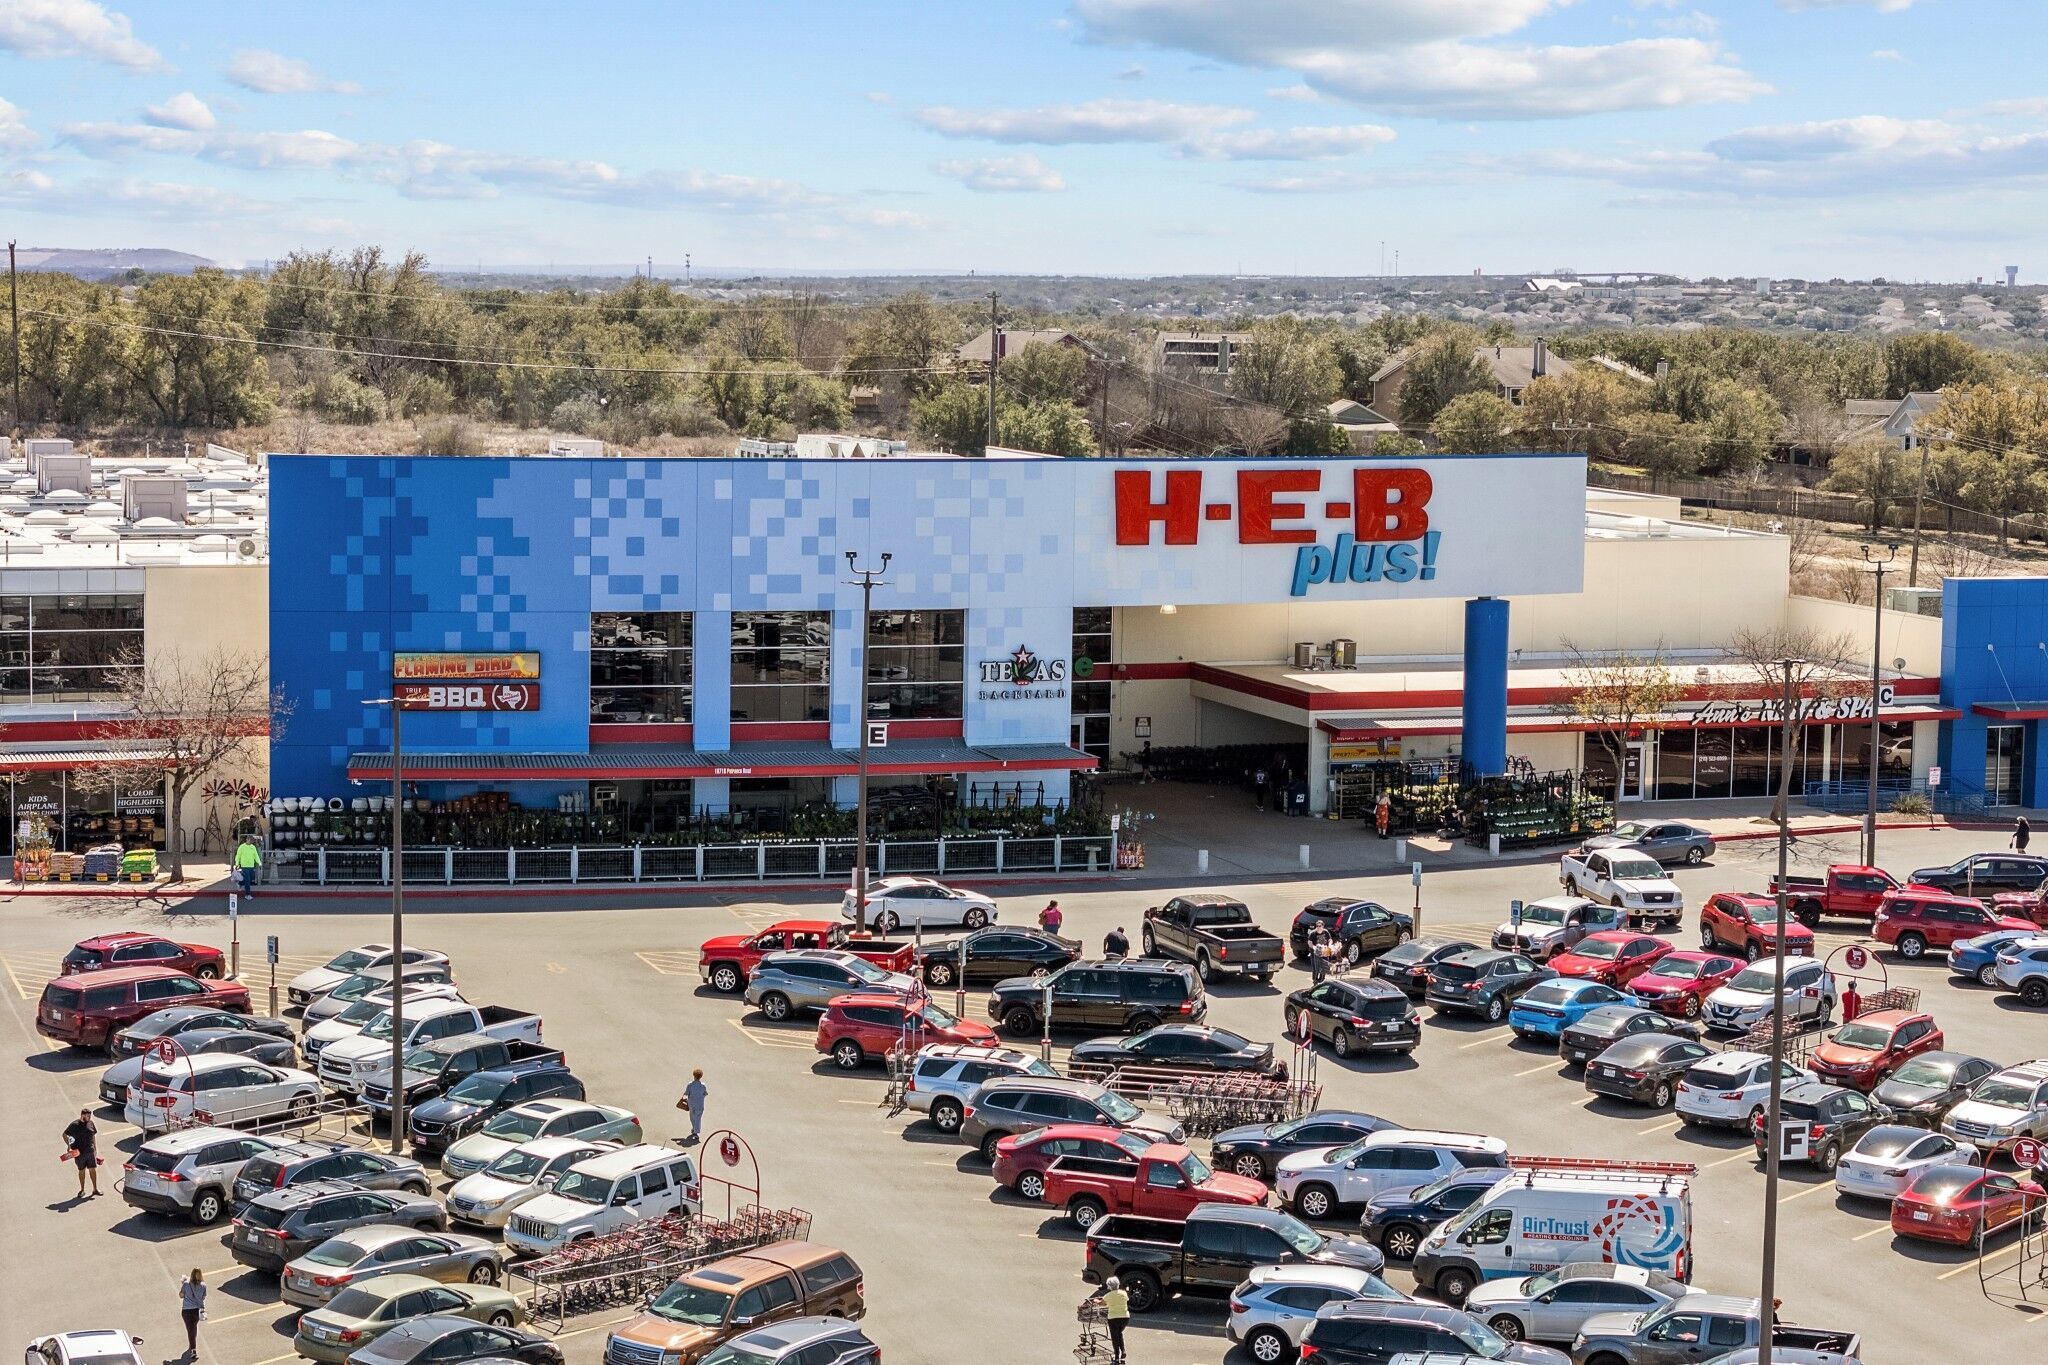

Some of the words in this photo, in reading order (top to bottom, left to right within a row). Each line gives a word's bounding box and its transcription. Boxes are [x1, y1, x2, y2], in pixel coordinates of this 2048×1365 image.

[1114, 468, 1433, 545] H-E-B
[1290, 531, 1442, 596] plus!
[395, 658, 467, 677] FLAMING
[474, 656, 513, 672] BIRD
[980, 659, 1066, 683] TEXAS
[429, 687, 486, 707] BBQ
[979, 689, 1067, 700] BACKYARD
[1880, 687, 1893, 704] C
[1692, 702, 1753, 725] Ann's
[1836, 697, 1874, 719] SPA
[870, 727, 885, 744] E
[117, 798, 165, 806] HIGHLIGHTS
[127, 789, 154, 797] COLOR
[18, 802, 59, 810] AIRPLANE
[1783, 1126, 1806, 1155] F
[1523, 1217, 1590, 1235] AirTrust
